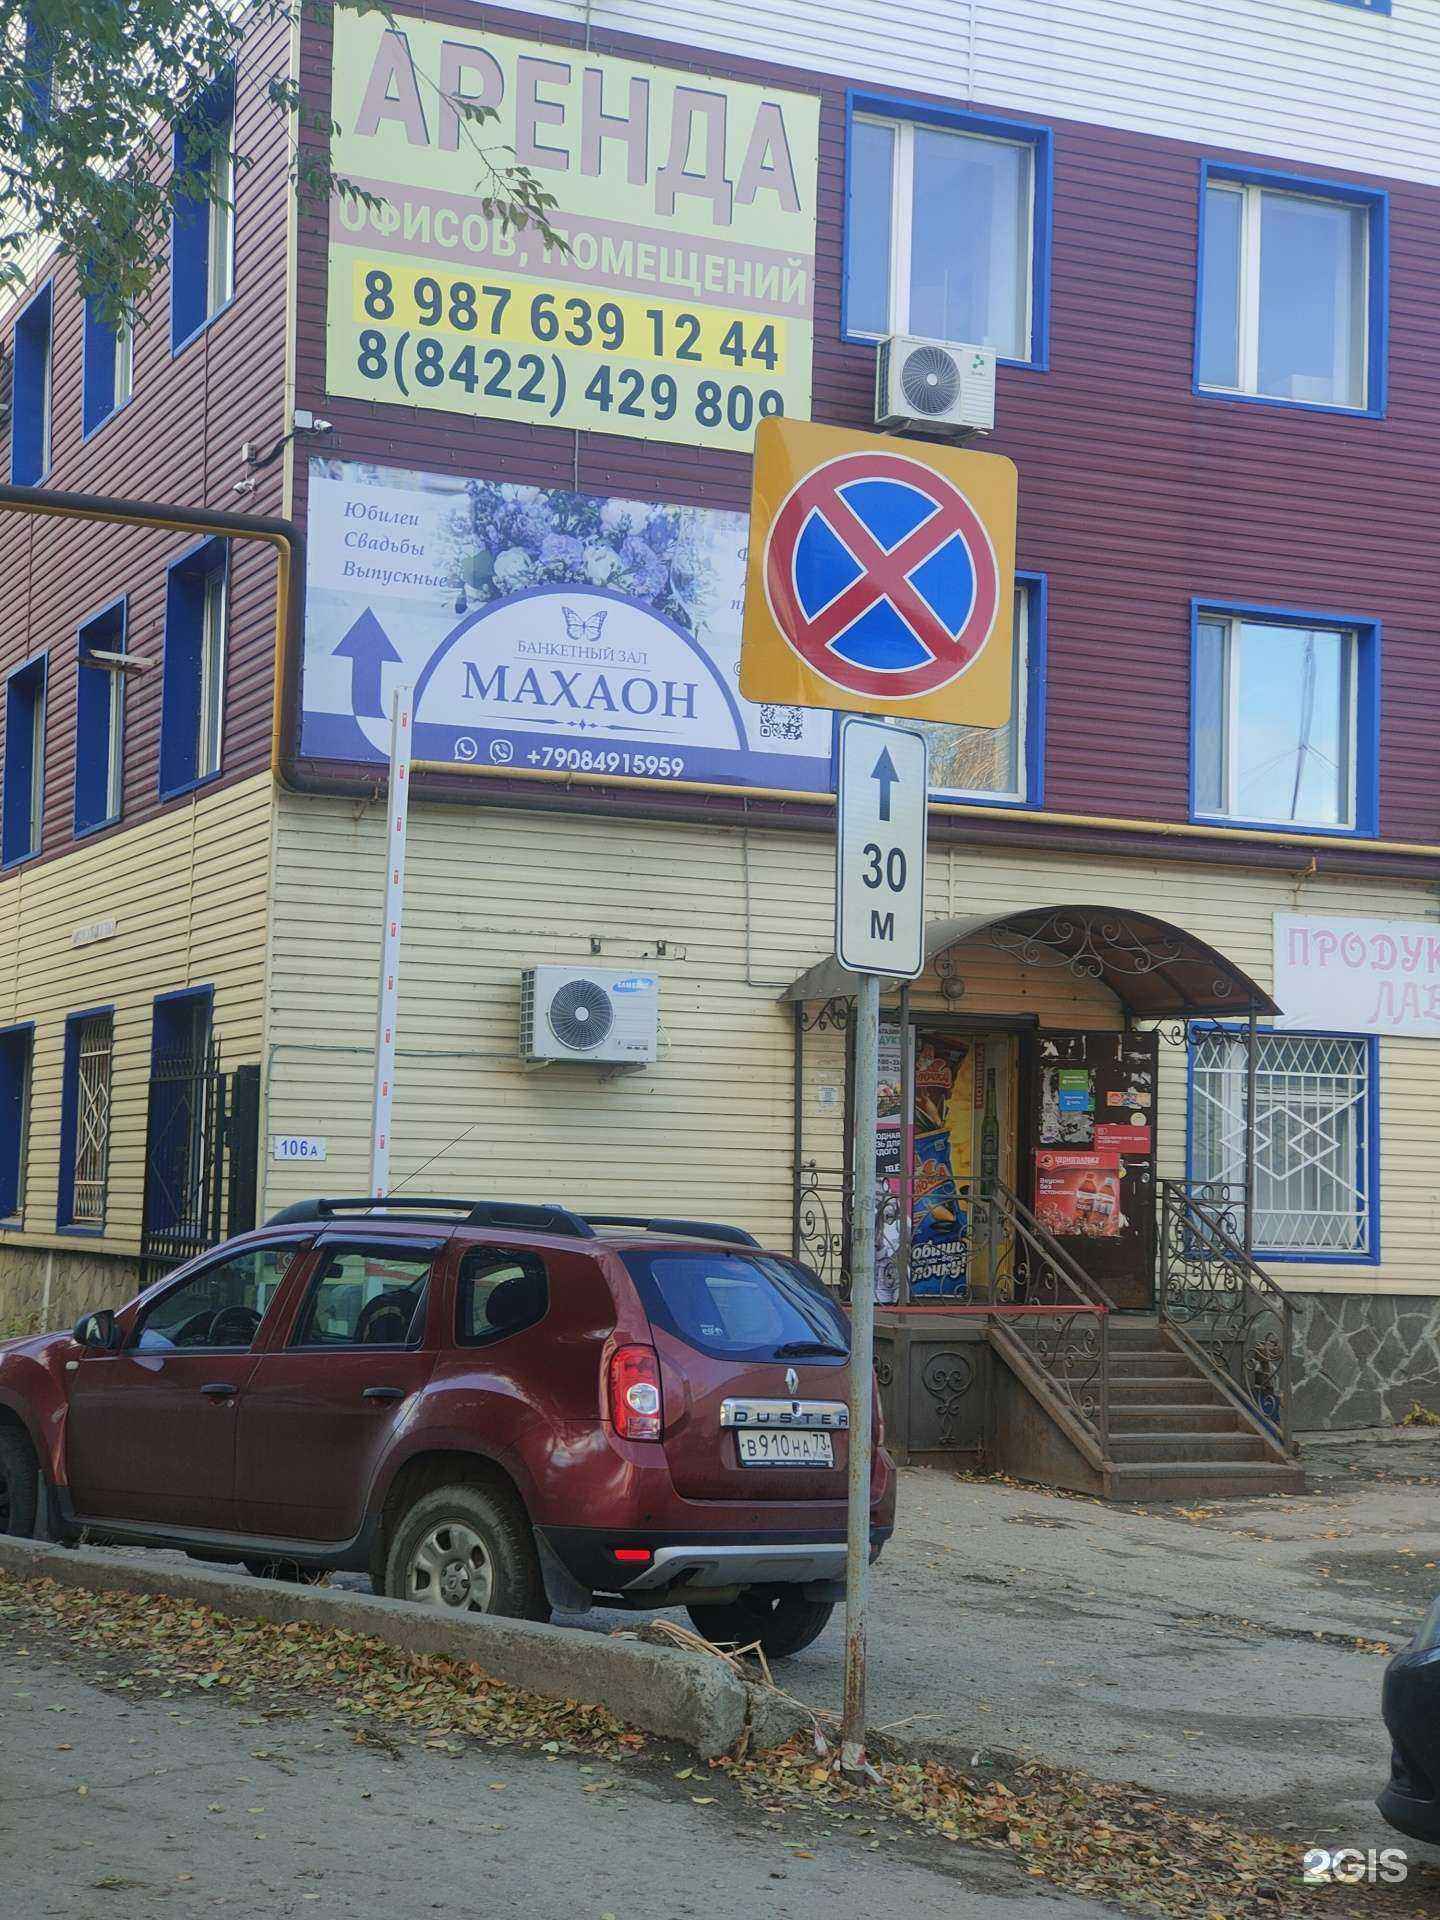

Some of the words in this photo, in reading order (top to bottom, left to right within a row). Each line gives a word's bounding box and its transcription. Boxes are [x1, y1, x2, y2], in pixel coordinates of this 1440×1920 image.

[354, 28, 801, 226] АРЕНДА
[542, 227, 807, 305] ПОМЕЩЕНИЙ
[364, 270, 395, 320] 8
[414, 277, 512, 334] 987
[531, 293, 625, 350] 639
[646, 309, 703, 361] 12
[719, 320, 778, 371] 44
[358, 329, 567, 418] 8(8422)
[585, 364, 677, 421] 429
[344, 531, 425, 556] Свадьбы
[342, 560, 449, 587] Выпускные
[518, 640, 615, 662] БАНКЕТНЫЙ
[618, 650, 648, 665] ЗАЛ
[462, 661, 699, 719] МАХАОН
[527, 747, 685, 778] +79084915959
[862, 843, 907, 893] 30
[734, 1411, 848, 1426] DUSTER
